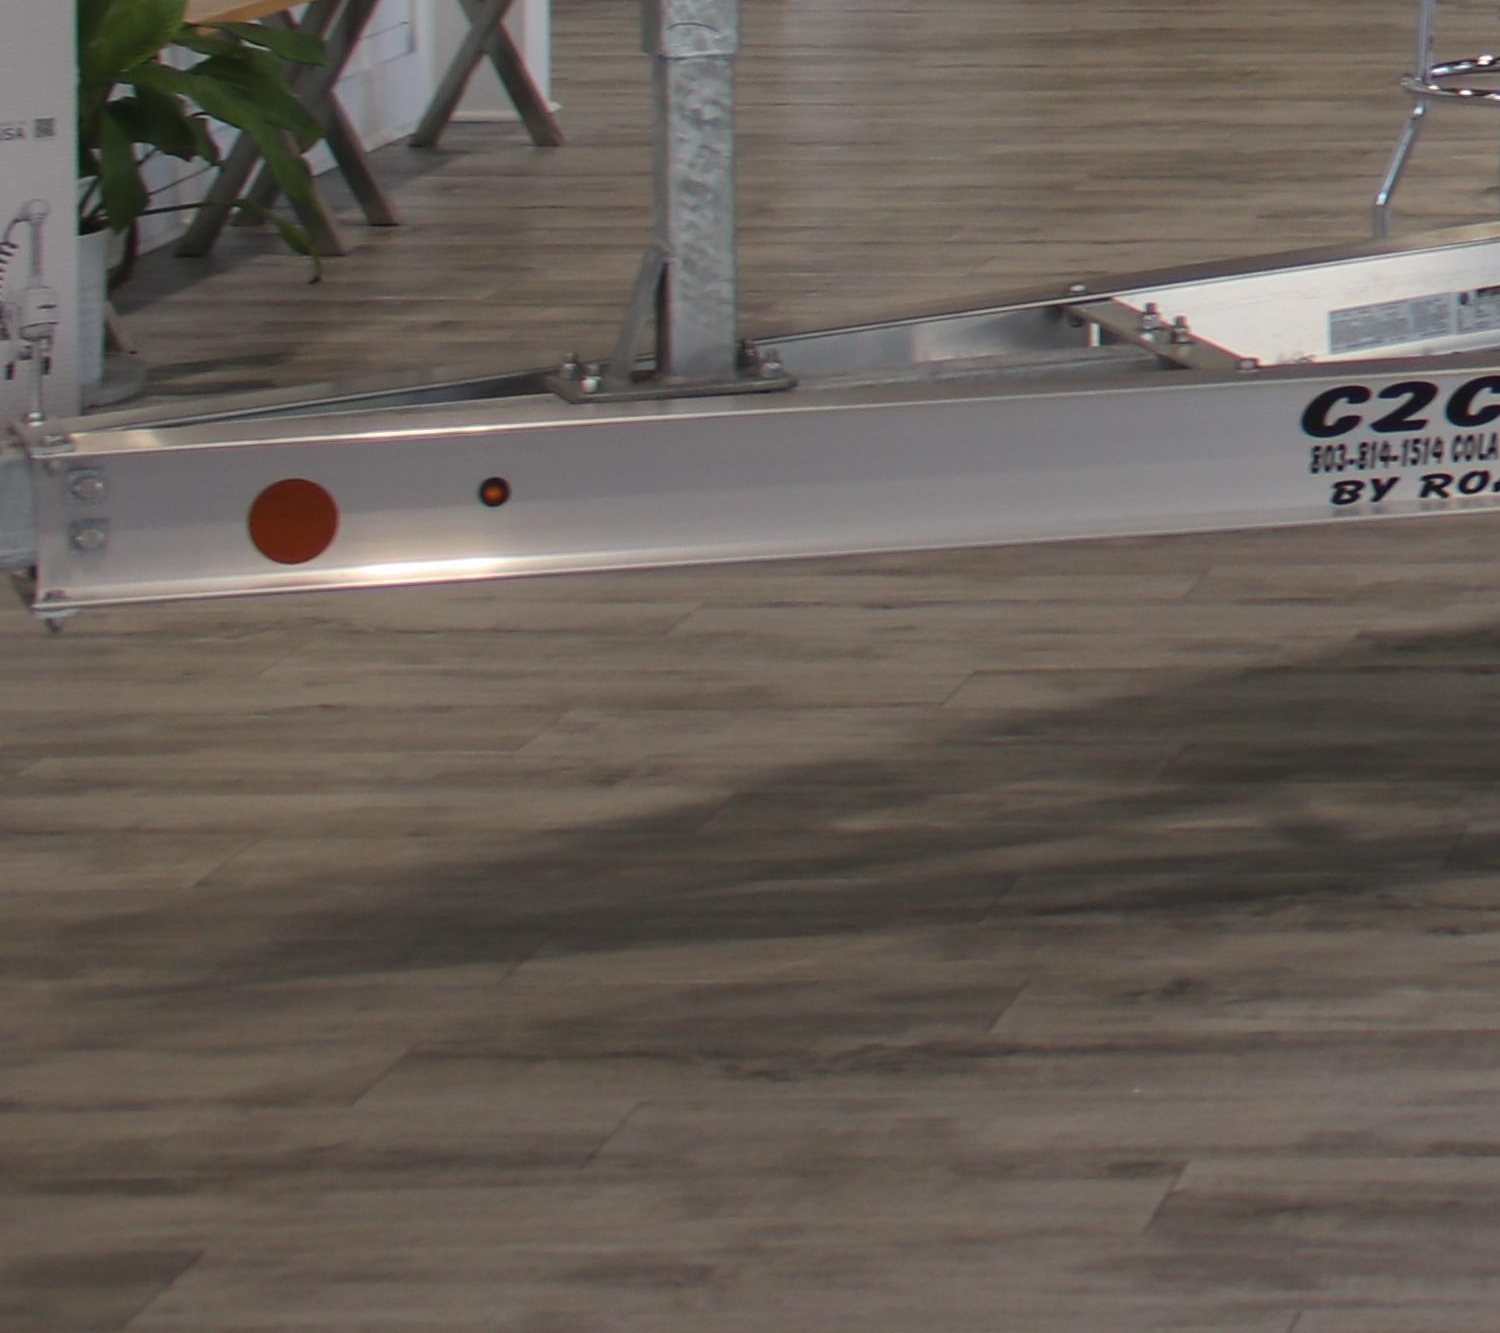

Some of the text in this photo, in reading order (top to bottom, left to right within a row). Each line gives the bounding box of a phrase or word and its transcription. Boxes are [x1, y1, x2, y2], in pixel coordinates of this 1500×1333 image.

[1310, 436, 1444, 474] 803-814-1514
[1451, 432, 1500, 463] COLA
[1330, 475, 1401, 506] BY
